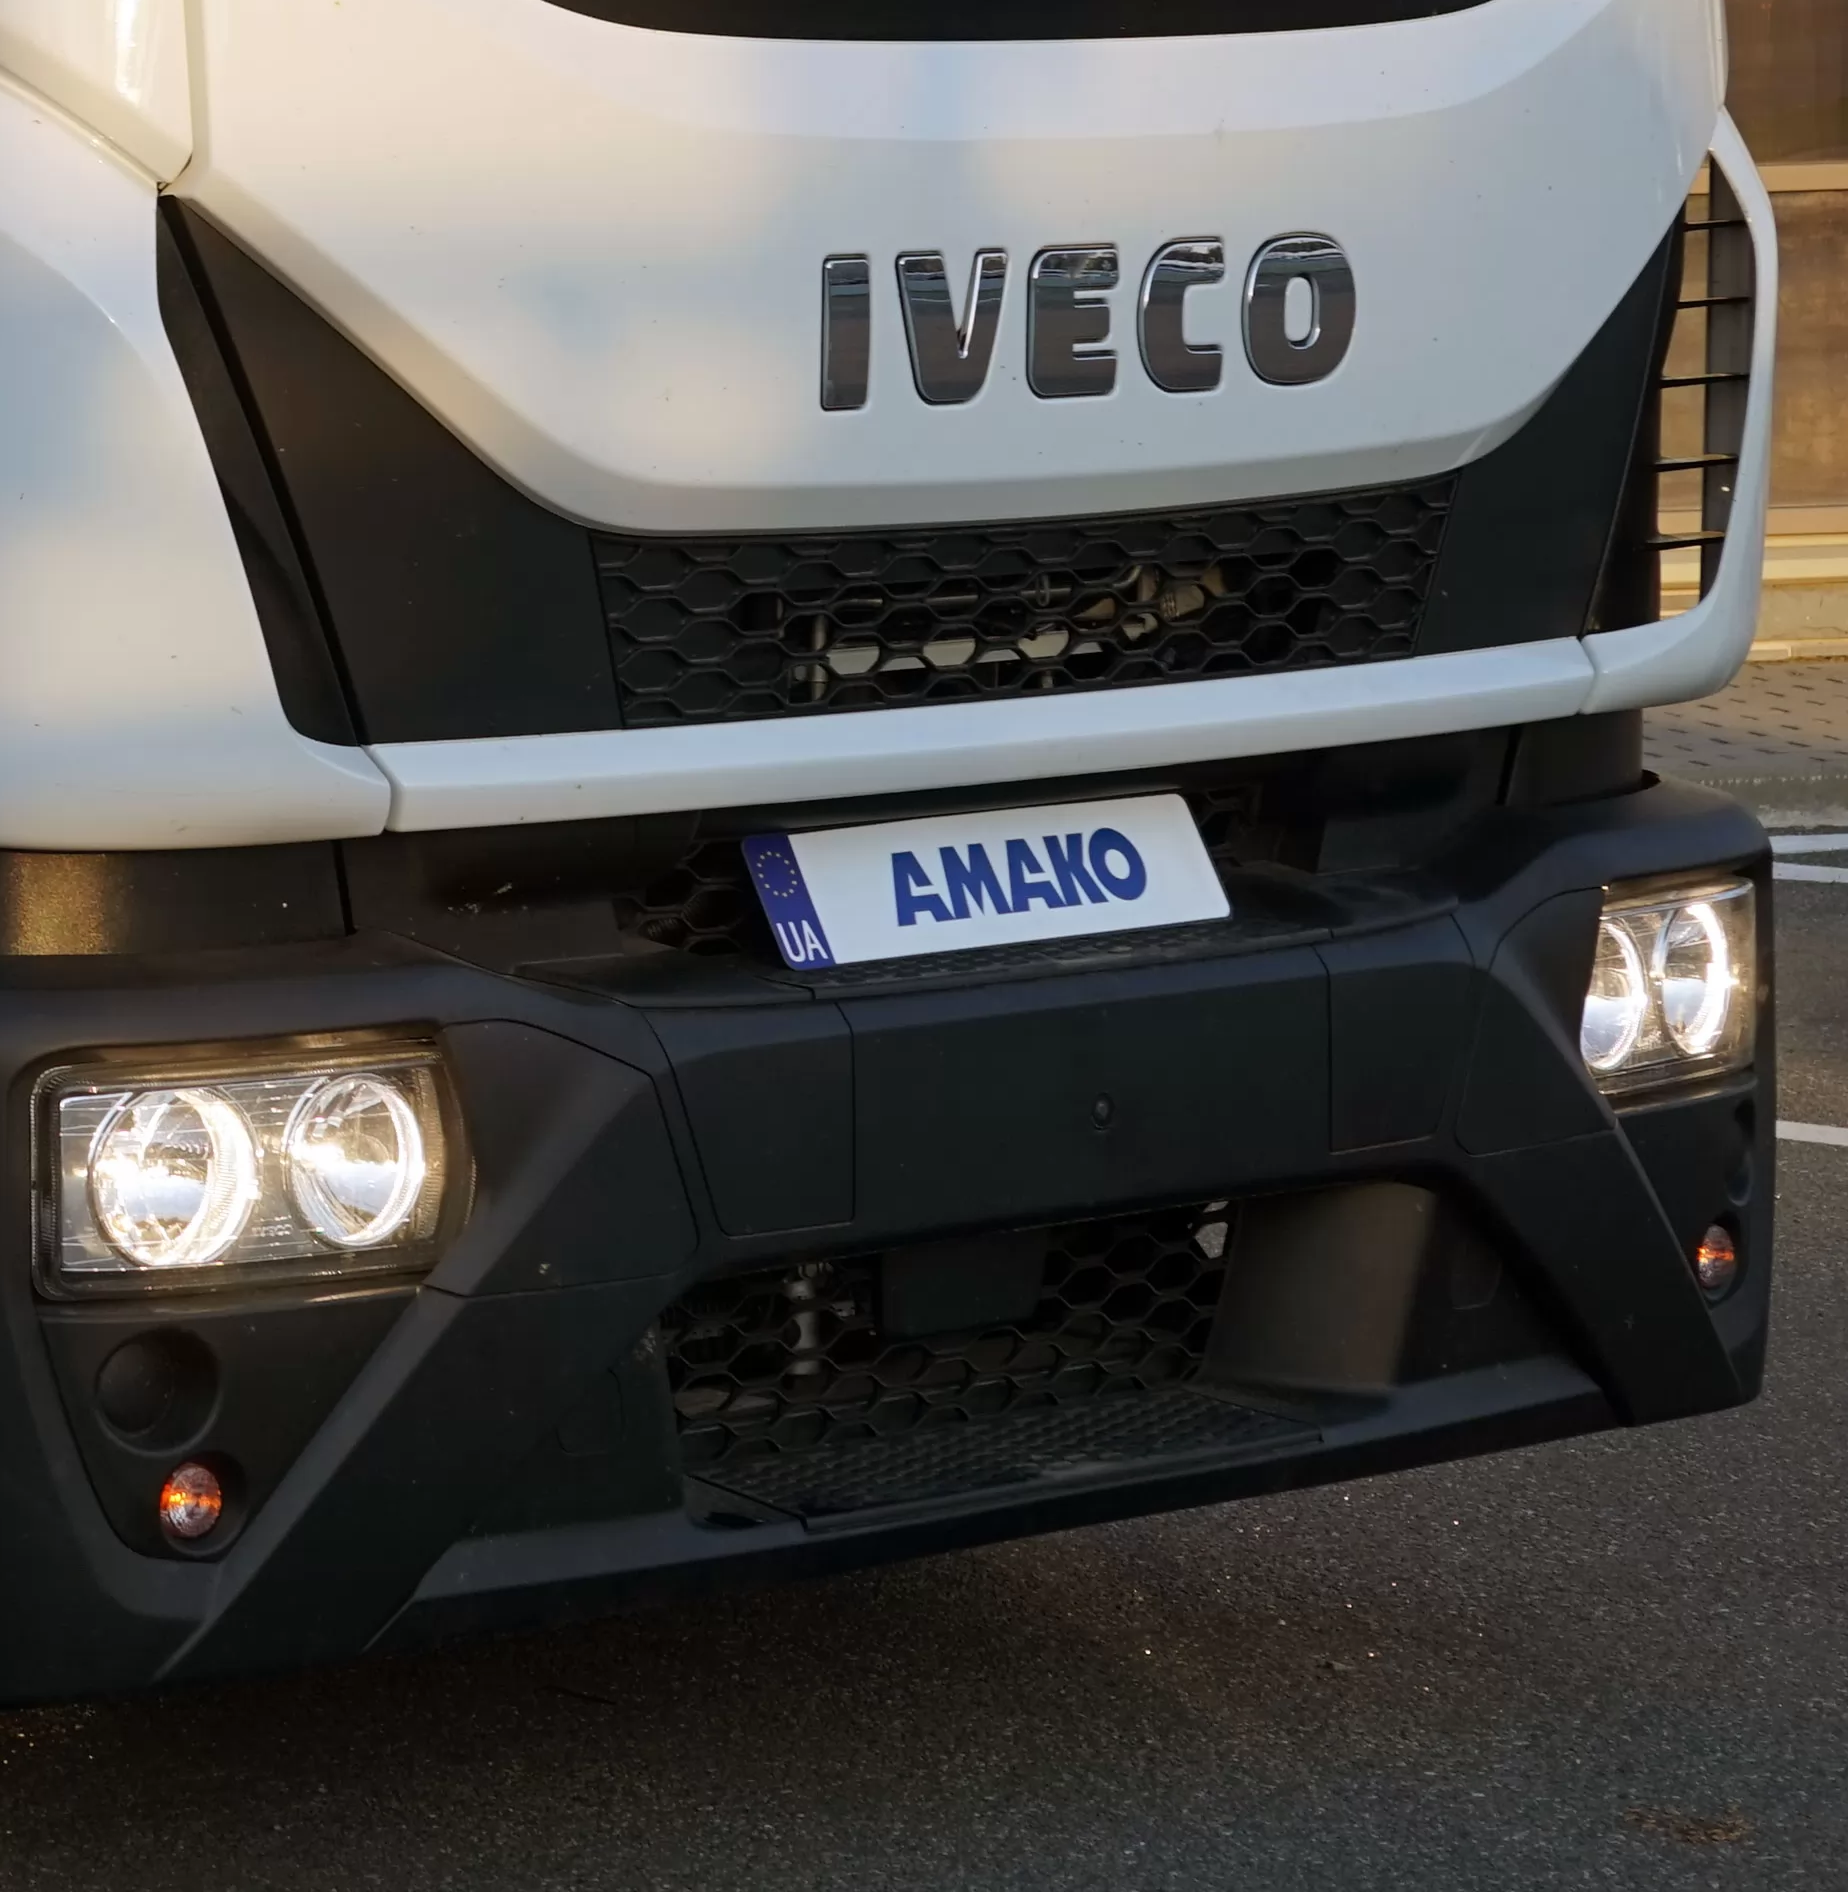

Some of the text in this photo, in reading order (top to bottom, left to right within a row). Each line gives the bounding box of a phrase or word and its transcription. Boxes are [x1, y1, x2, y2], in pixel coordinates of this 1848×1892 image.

[819, 231, 1357, 412] IVECO
[891, 827, 1147, 927] AMAKO
[776, 919, 829, 963] UA
